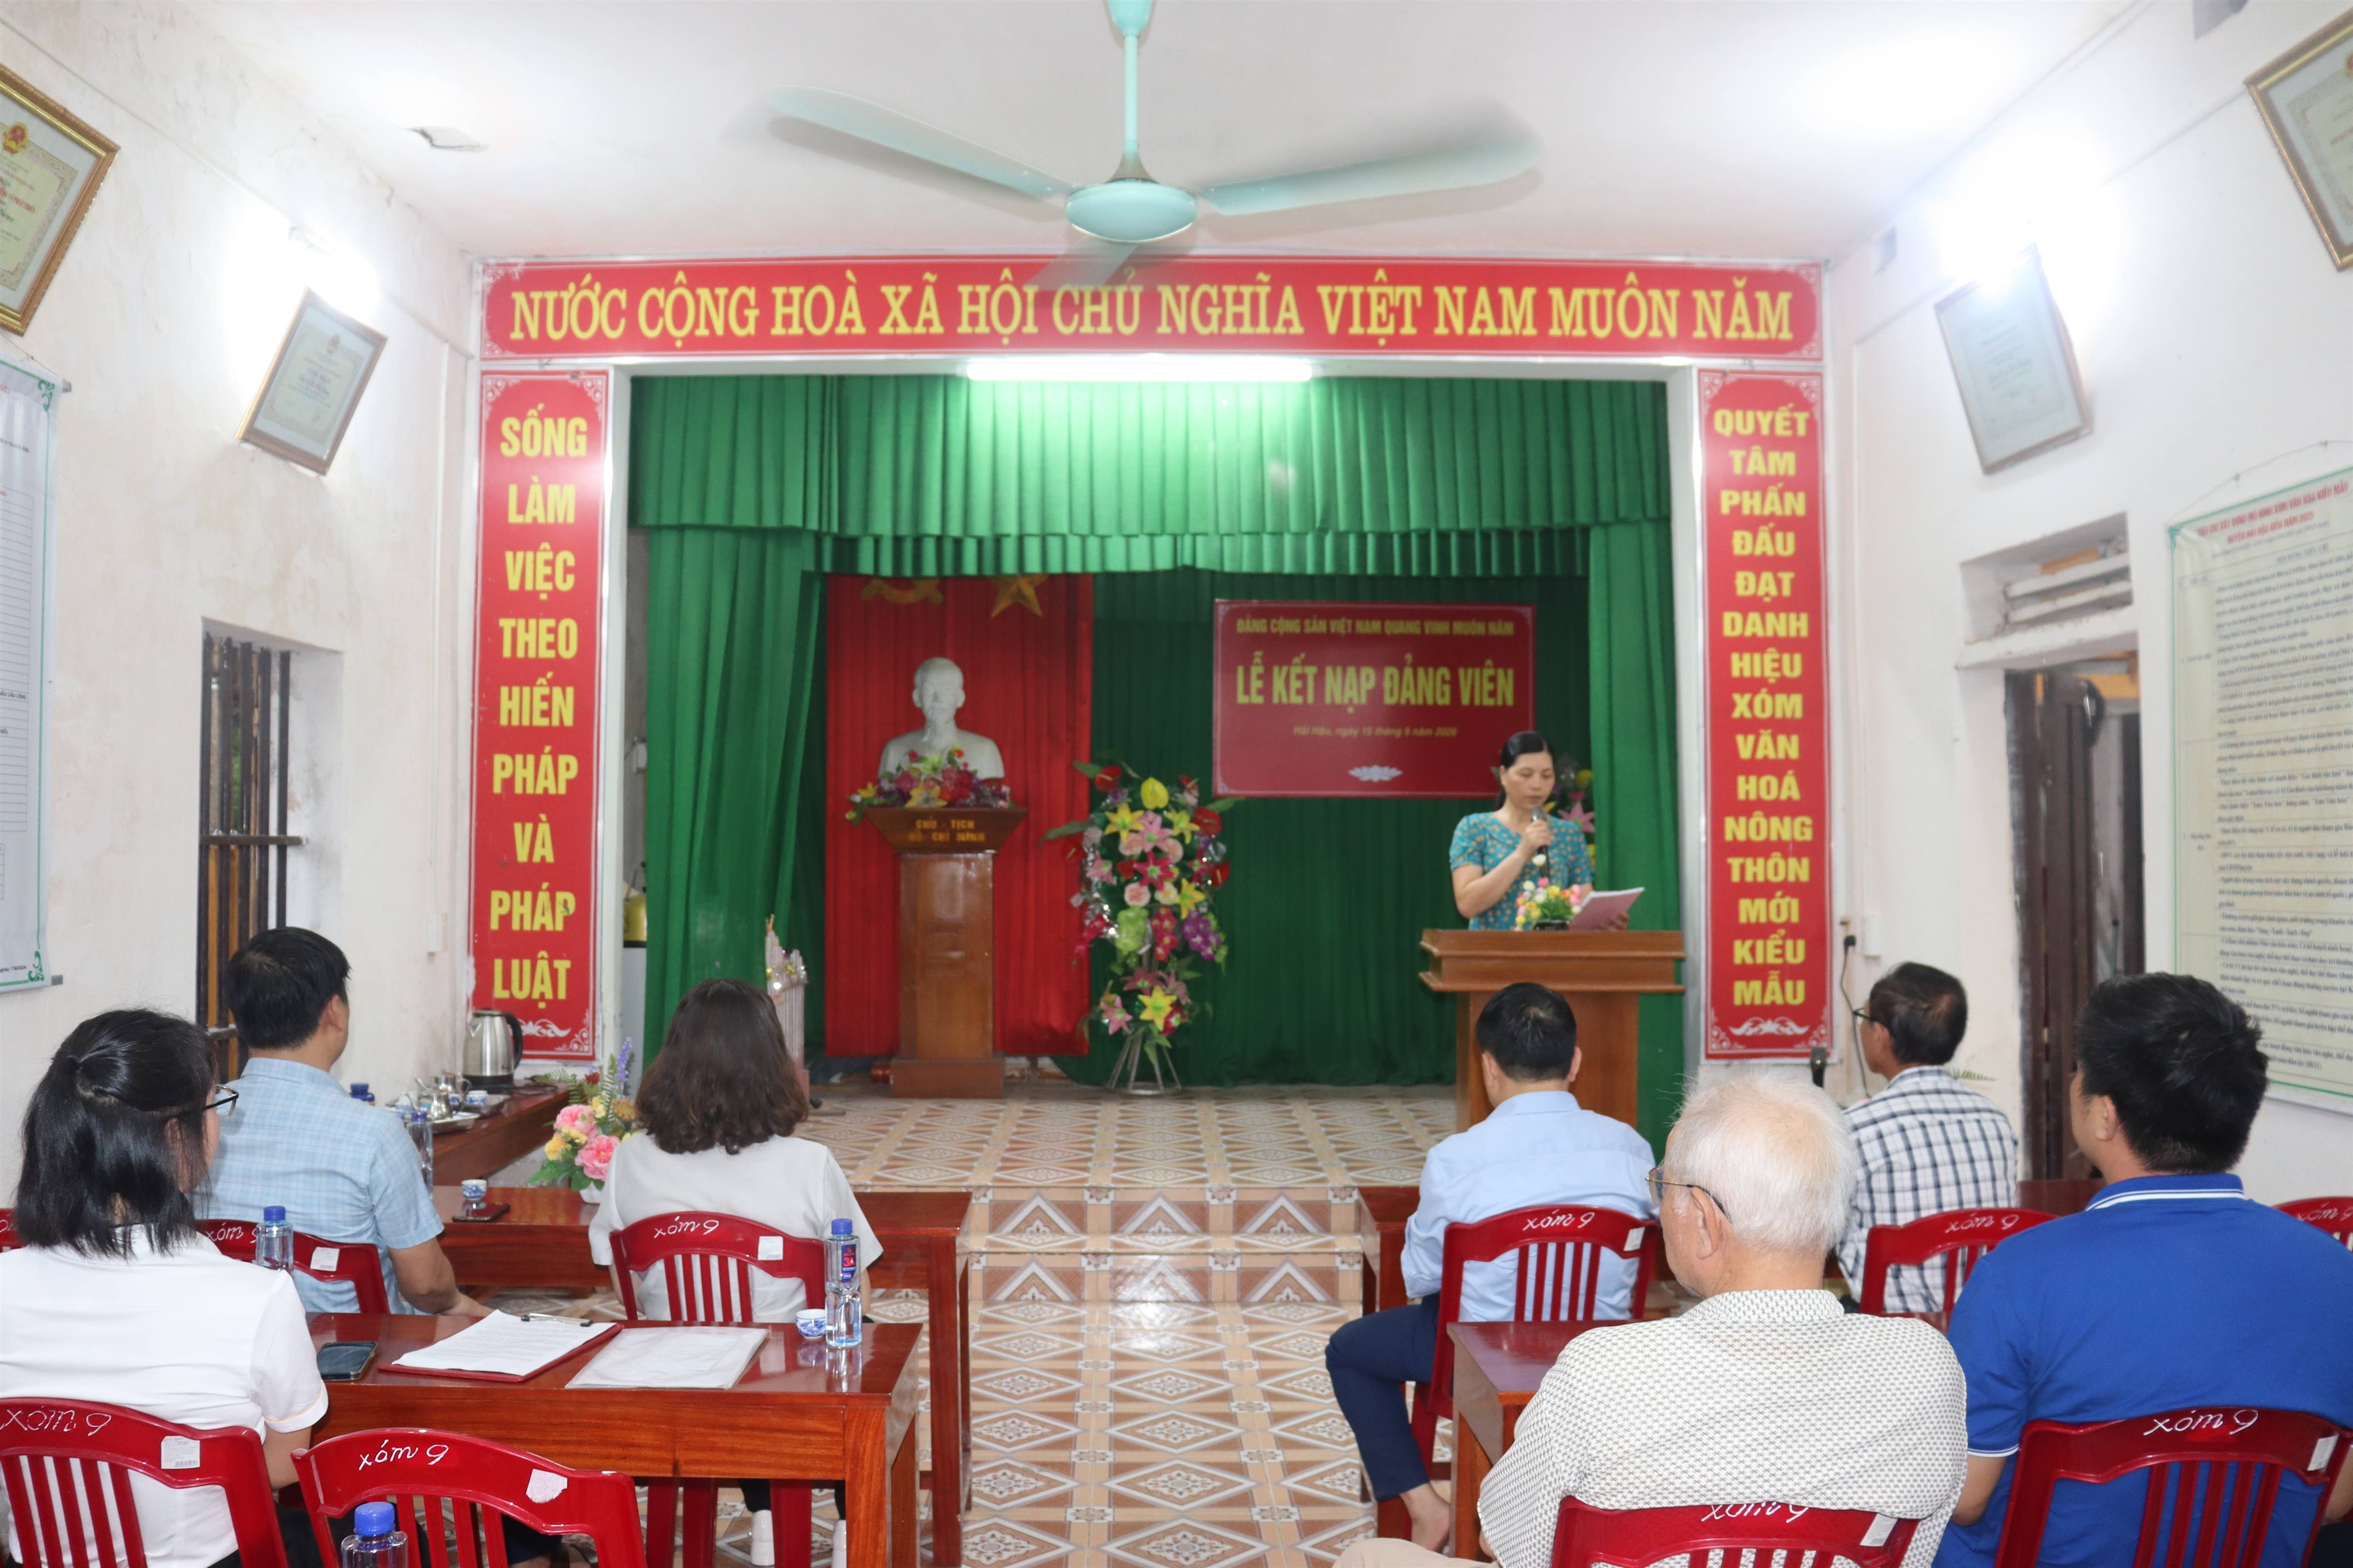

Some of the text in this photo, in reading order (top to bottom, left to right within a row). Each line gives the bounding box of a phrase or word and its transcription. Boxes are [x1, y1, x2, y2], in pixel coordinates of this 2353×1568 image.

[510, 267, 1793, 348] NƯỚC CỘNG HOÀ XÃ HỘI CHỦ NGHĨA VIỆT NAM MUÔN NĂM
[500, 404, 588, 457] SỐNG
[1714, 403, 1810, 437] QUYẾT
[1730, 446, 1796, 476] TÂM
[507, 476, 575, 524] LÀM
[1720, 484, 1807, 516] PHẤN
[1731, 523, 1796, 557] ĐẤU
[504, 542, 576, 601] VIỆC
[1734, 570, 1795, 603] ĐẠT
[498, 617, 578, 659] THEO
[1329, 617, 1352, 636] VIỆT
[1355, 620, 1382, 634] NAM
[1722, 611, 1809, 638] DANH
[1237, 651, 1514, 713] LỄ KẾT NẠP ĐẢNG VIÊN
[1730, 647, 1803, 684] HIỆU
[499, 671, 575, 727] HIẾN
[1731, 688, 1804, 720] XÓM
[1735, 729, 1800, 760] VĂN
[492, 745, 579, 795] PHÁP
[1737, 769, 1802, 802] HOÁ
[512, 813, 555, 864] VÀ
[1724, 810, 1814, 843] NÔNG
[1727, 851, 1811, 883] THÔN
[489, 882, 576, 932] PHÁP
[1738, 890, 1800, 924] MỚI
[1733, 928, 1807, 965] KIỂU
[493, 949, 572, 1009] LUẬT
[1733, 970, 1806, 1006] MẪU
[653, 1215, 719, 1238] xóm 9
[1523, 1209, 1595, 1231] xóm 9
[1945, 1213, 1995, 1234] xóm
[86, 1413, 111, 1436] 9
[2143, 1409, 2258, 1436] xóm 9
[358, 1439, 449, 1471] xóm 9
